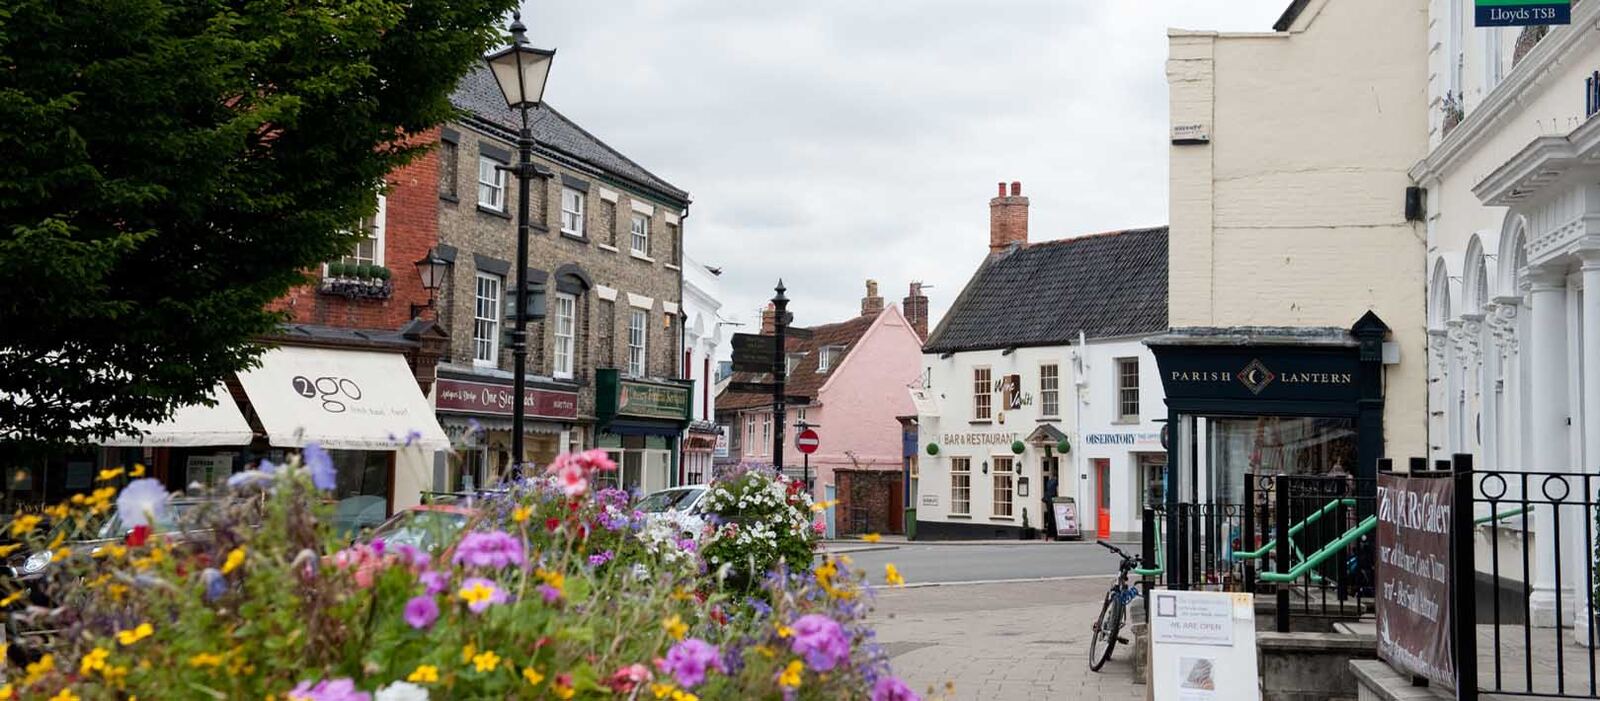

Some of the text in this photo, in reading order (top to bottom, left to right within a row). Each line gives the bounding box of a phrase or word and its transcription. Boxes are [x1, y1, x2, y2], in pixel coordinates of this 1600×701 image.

[1490, 7, 1556, 22] Lloyds TSB
[1172, 371, 1351, 384] PARISH LANTERN
[994, 378, 1015, 393] Wine
[292, 375, 362, 413] 2go
[481, 388, 497, 406] One
[1010, 391, 1033, 408] Vaults
[944, 433, 960, 445] BAR
[966, 433, 1018, 446] RESTAURANT
[1085, 433, 1136, 445] OBSERVATORY
[1183, 622, 1197, 631] ARE
[1200, 623, 1221, 632] OPEN
